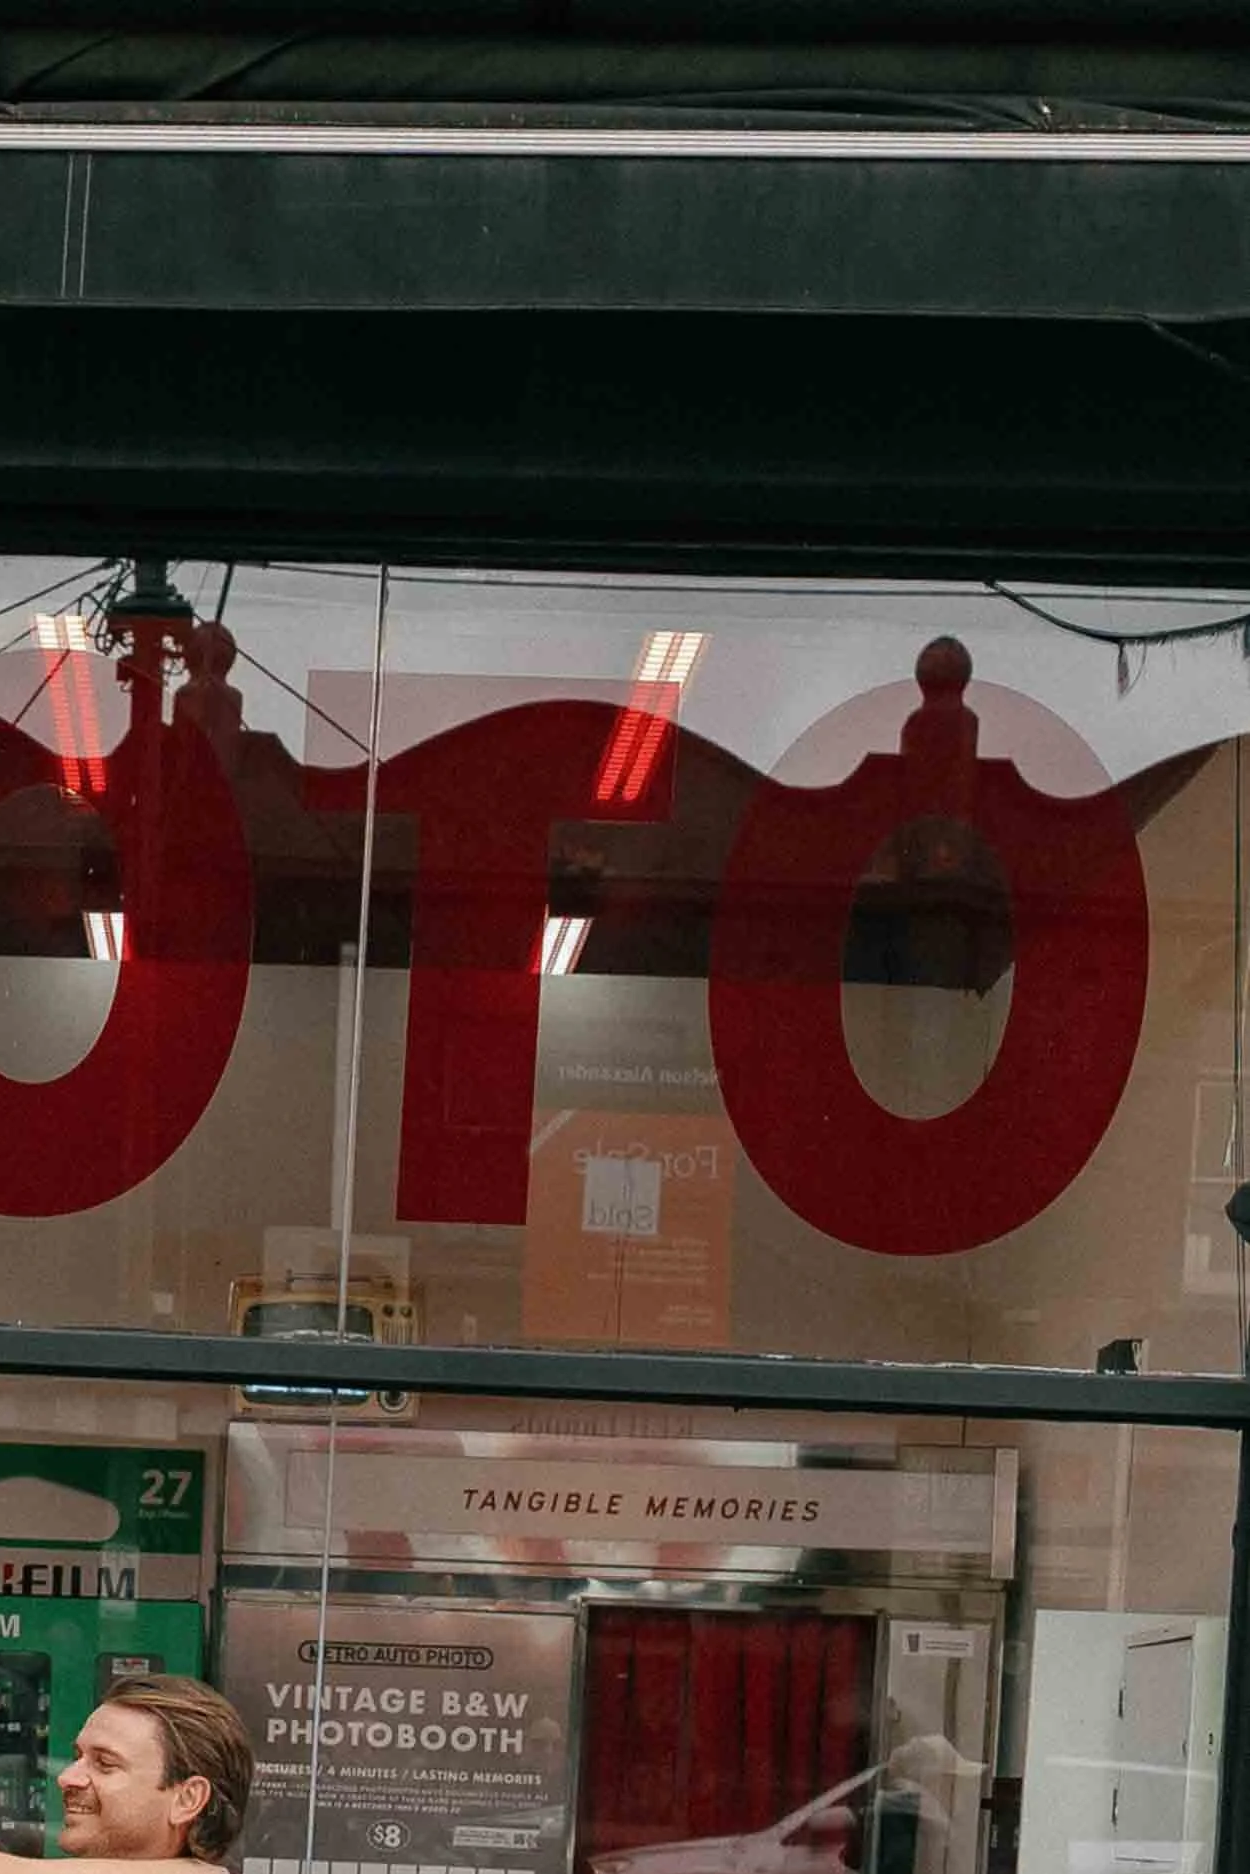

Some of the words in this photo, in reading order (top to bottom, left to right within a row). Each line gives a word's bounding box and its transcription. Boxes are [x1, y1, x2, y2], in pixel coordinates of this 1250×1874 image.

[139, 1469, 193, 1506] 27
[463, 1488, 623, 1516] TANGIBLE
[645, 1495, 821, 1522] MEMORIES
[373, 1647, 421, 1664] AUTO
[426, 1649, 486, 1667] PHOTO
[266, 1682, 425, 1714] VINTAGE
[441, 1690, 529, 1719] B&W
[266, 1718, 524, 1755] PHOTOBOOTH
[253, 1761, 312, 1776] PICTURES
[339, 1765, 398, 1779] MINUTES
[412, 1768, 469, 1783] LASTING
[472, 1772, 542, 1786] MEMORIES
[372, 1823, 401, 1848] $8
